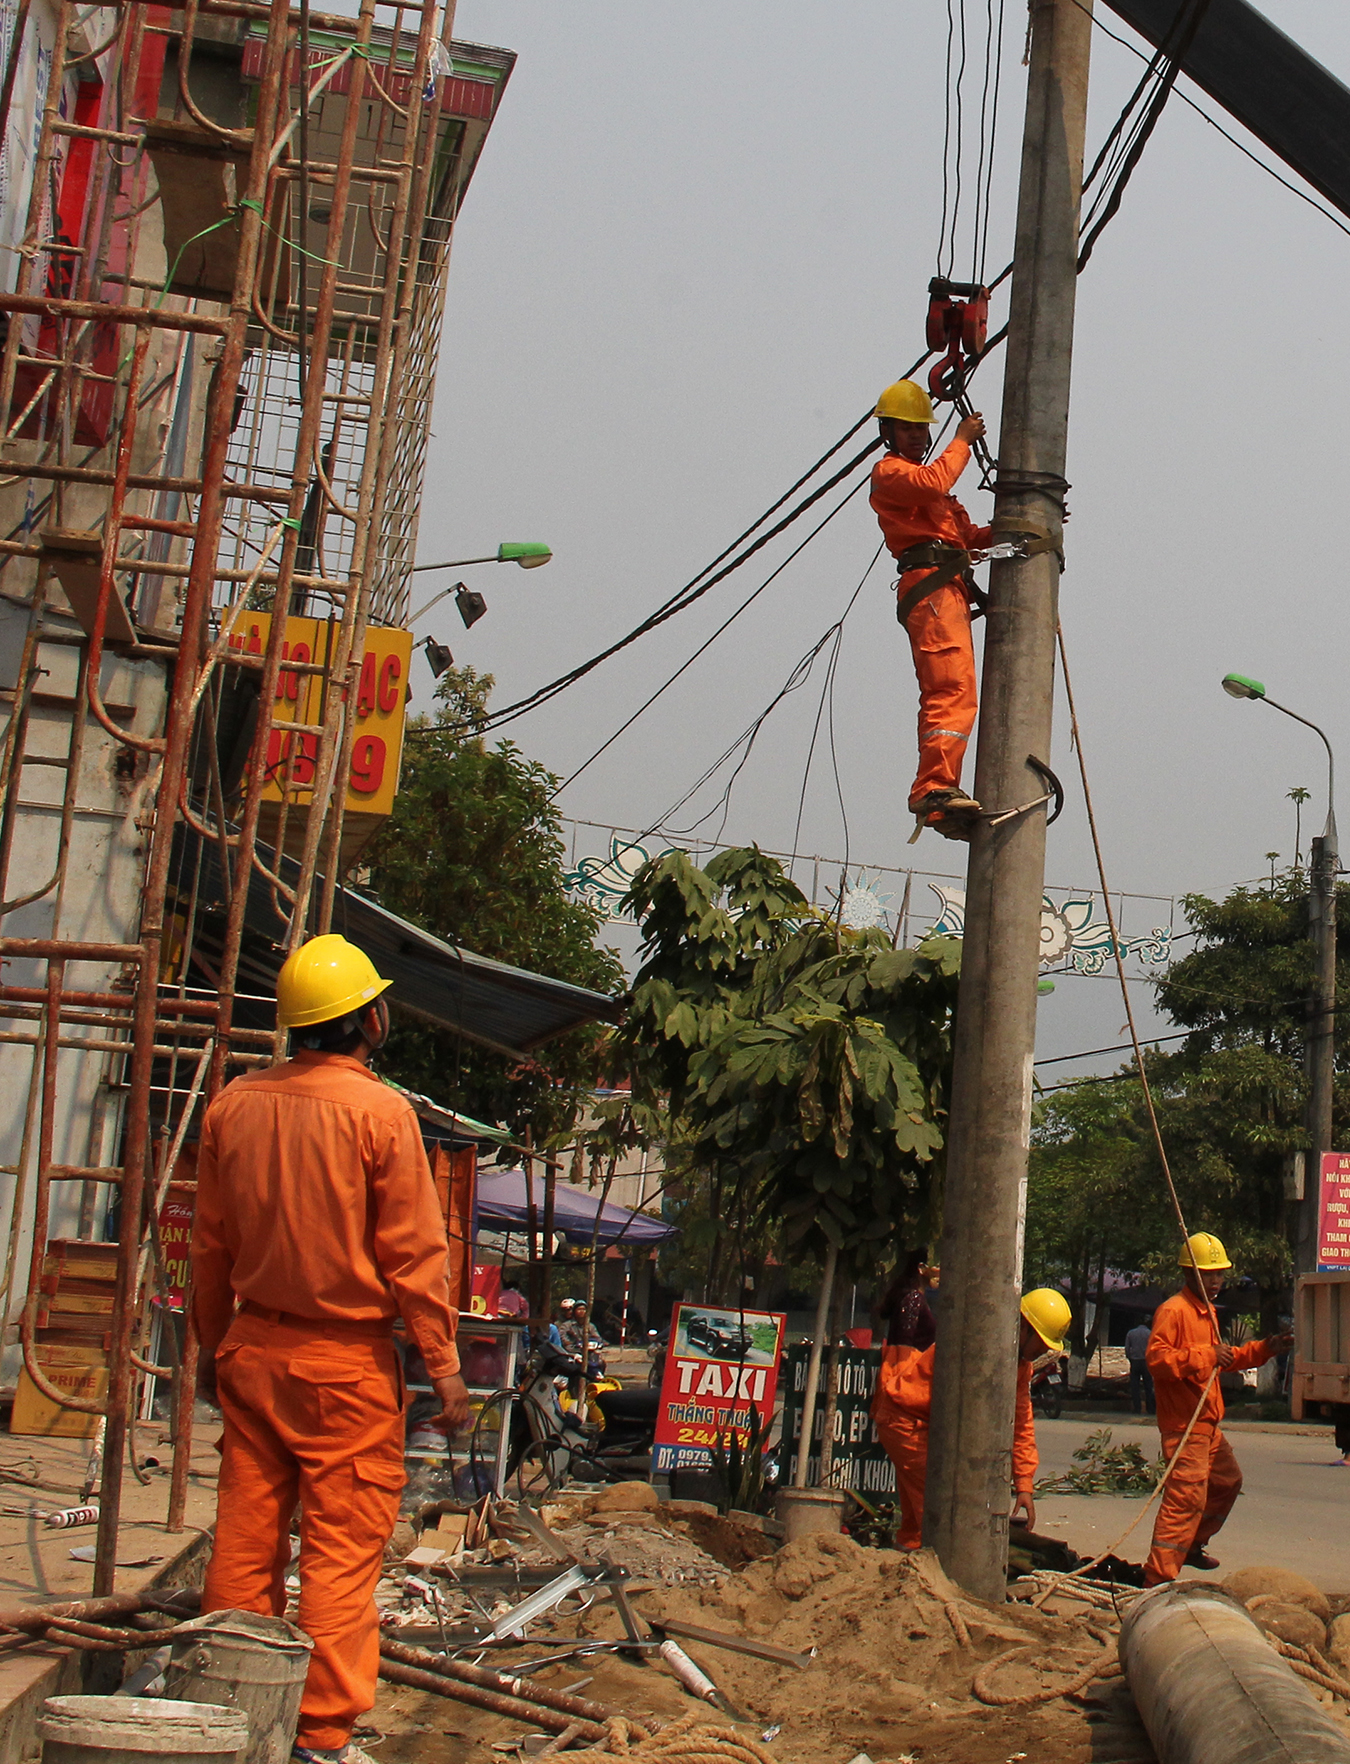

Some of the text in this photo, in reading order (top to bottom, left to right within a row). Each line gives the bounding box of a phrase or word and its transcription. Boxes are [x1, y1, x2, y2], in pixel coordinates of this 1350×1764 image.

[1326, 1172, 1339, 1183] NÓI
[1326, 1202, 1349, 1215] RƯỢU,
[1337, 1218, 1350, 1228] KHI
[1326, 1232, 1347, 1243] THAM
[1321, 1247, 1339, 1257] GIAO
[48, 1374, 97, 1388] PRIME
[676, 1360, 767, 1401] TAXI
